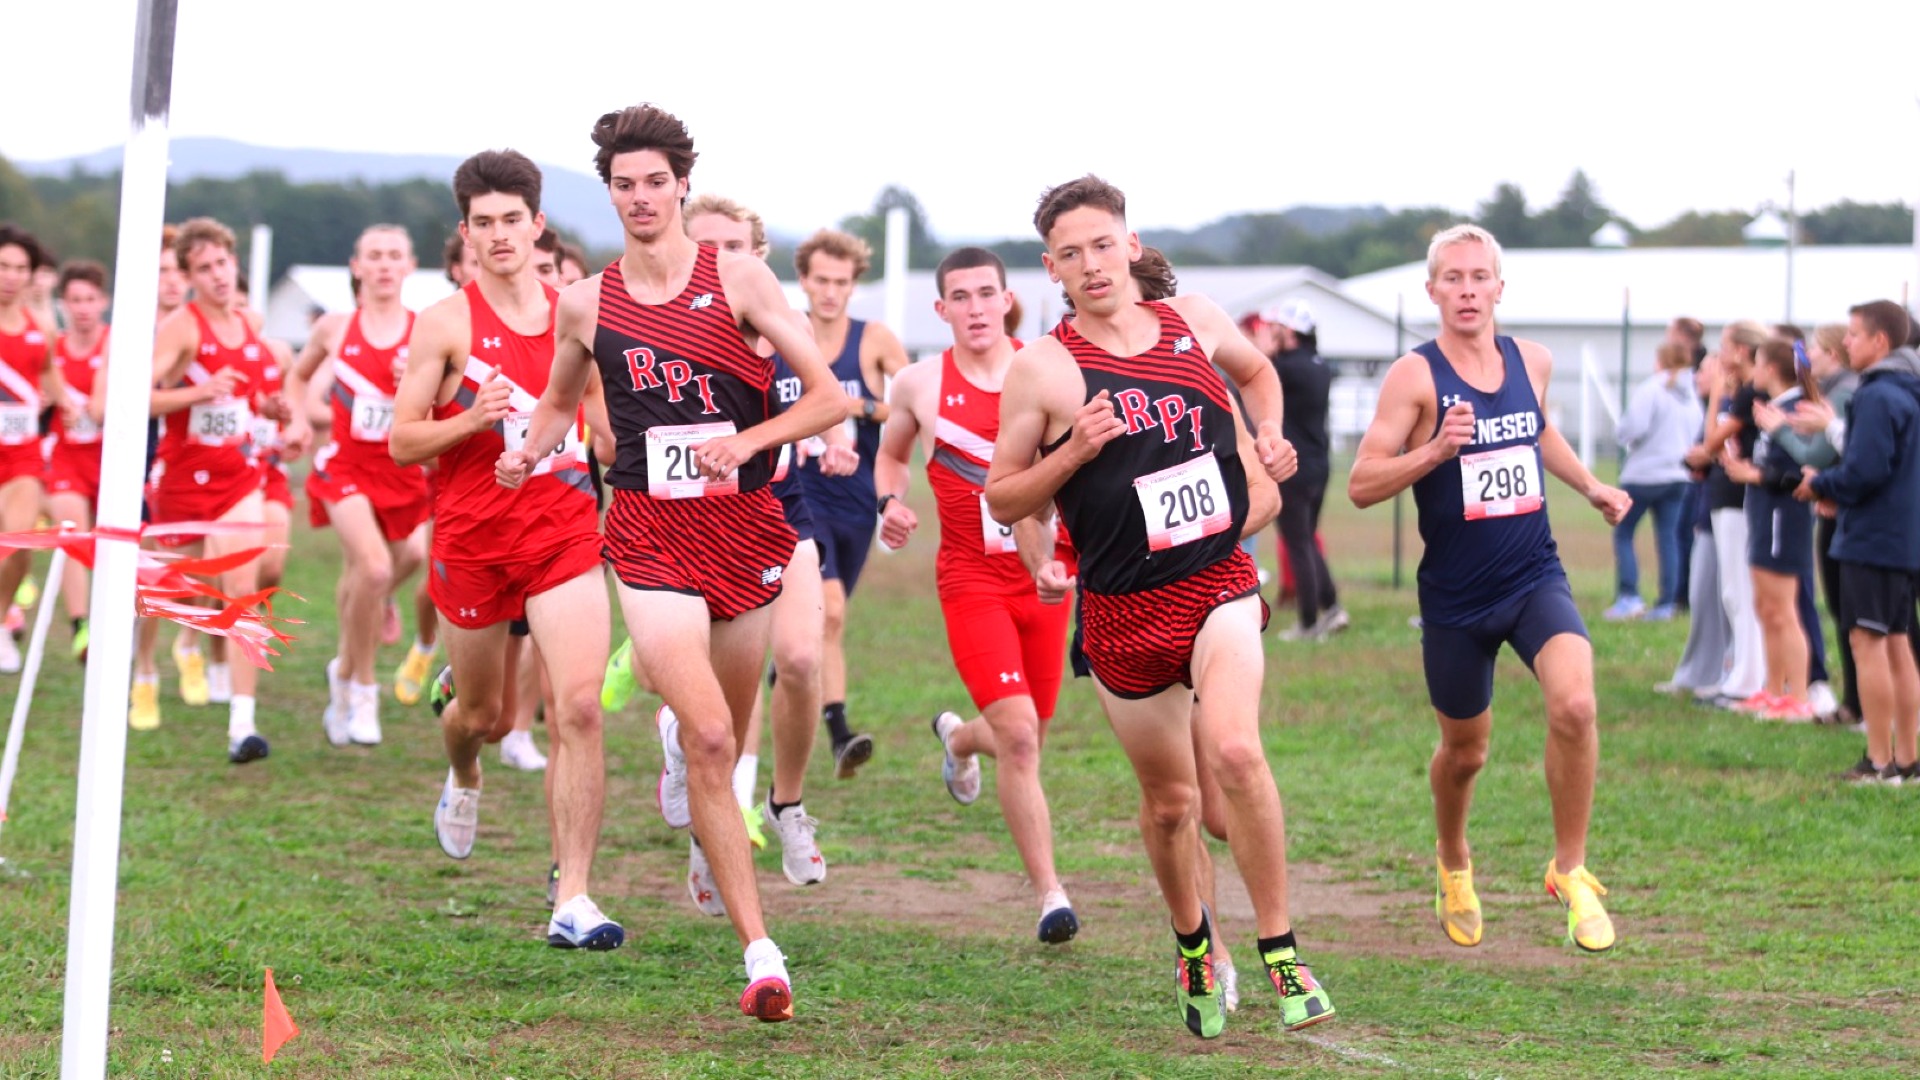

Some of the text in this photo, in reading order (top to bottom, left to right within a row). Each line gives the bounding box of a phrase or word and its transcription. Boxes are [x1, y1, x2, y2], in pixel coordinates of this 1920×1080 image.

[622, 347, 720, 414] RPI
[201, 411, 237, 436] 385
[1113, 388, 1205, 451] RPI
[1159, 478, 1215, 529] 208
[1478, 465, 1528, 502] 298
